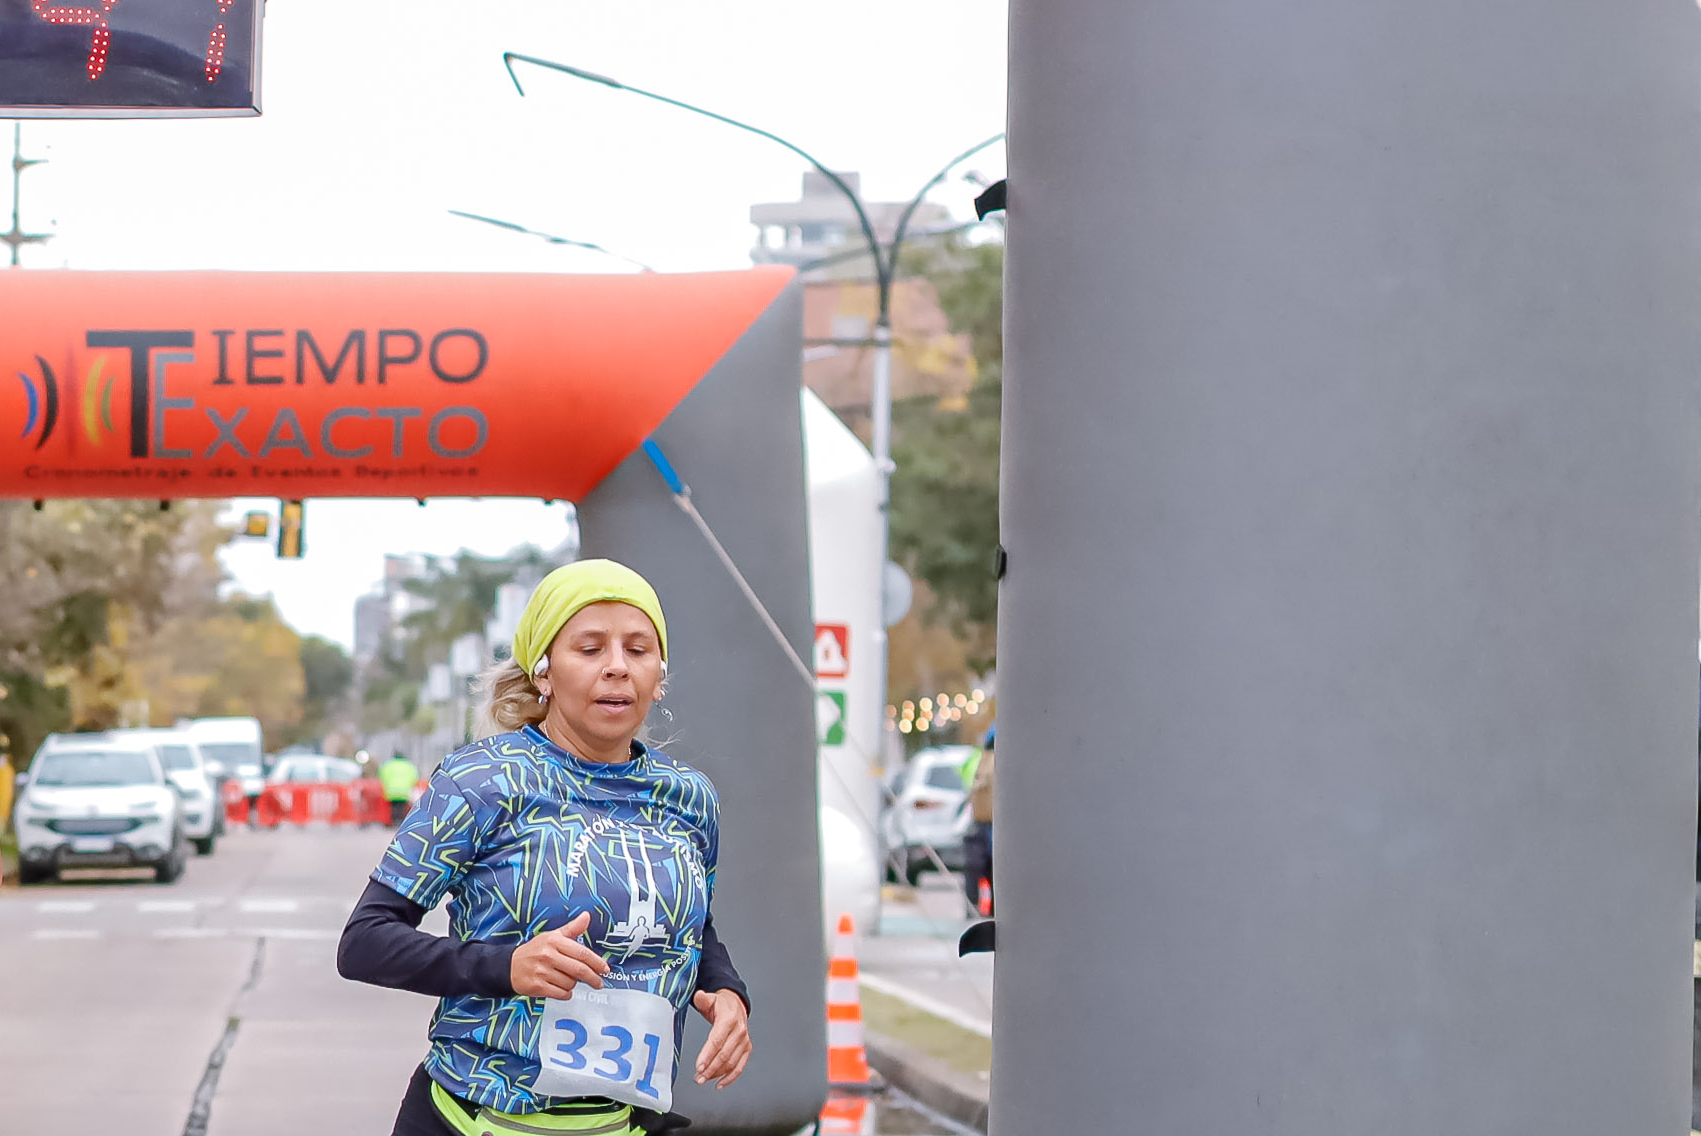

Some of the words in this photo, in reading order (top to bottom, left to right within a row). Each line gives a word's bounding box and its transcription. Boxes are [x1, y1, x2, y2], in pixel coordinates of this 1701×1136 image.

[86, 329, 489, 458] TIEMPO
[154, 353, 489, 459] EXACTO
[566, 817, 615, 878] MARATÓN
[550, 1018, 661, 1099] 331
